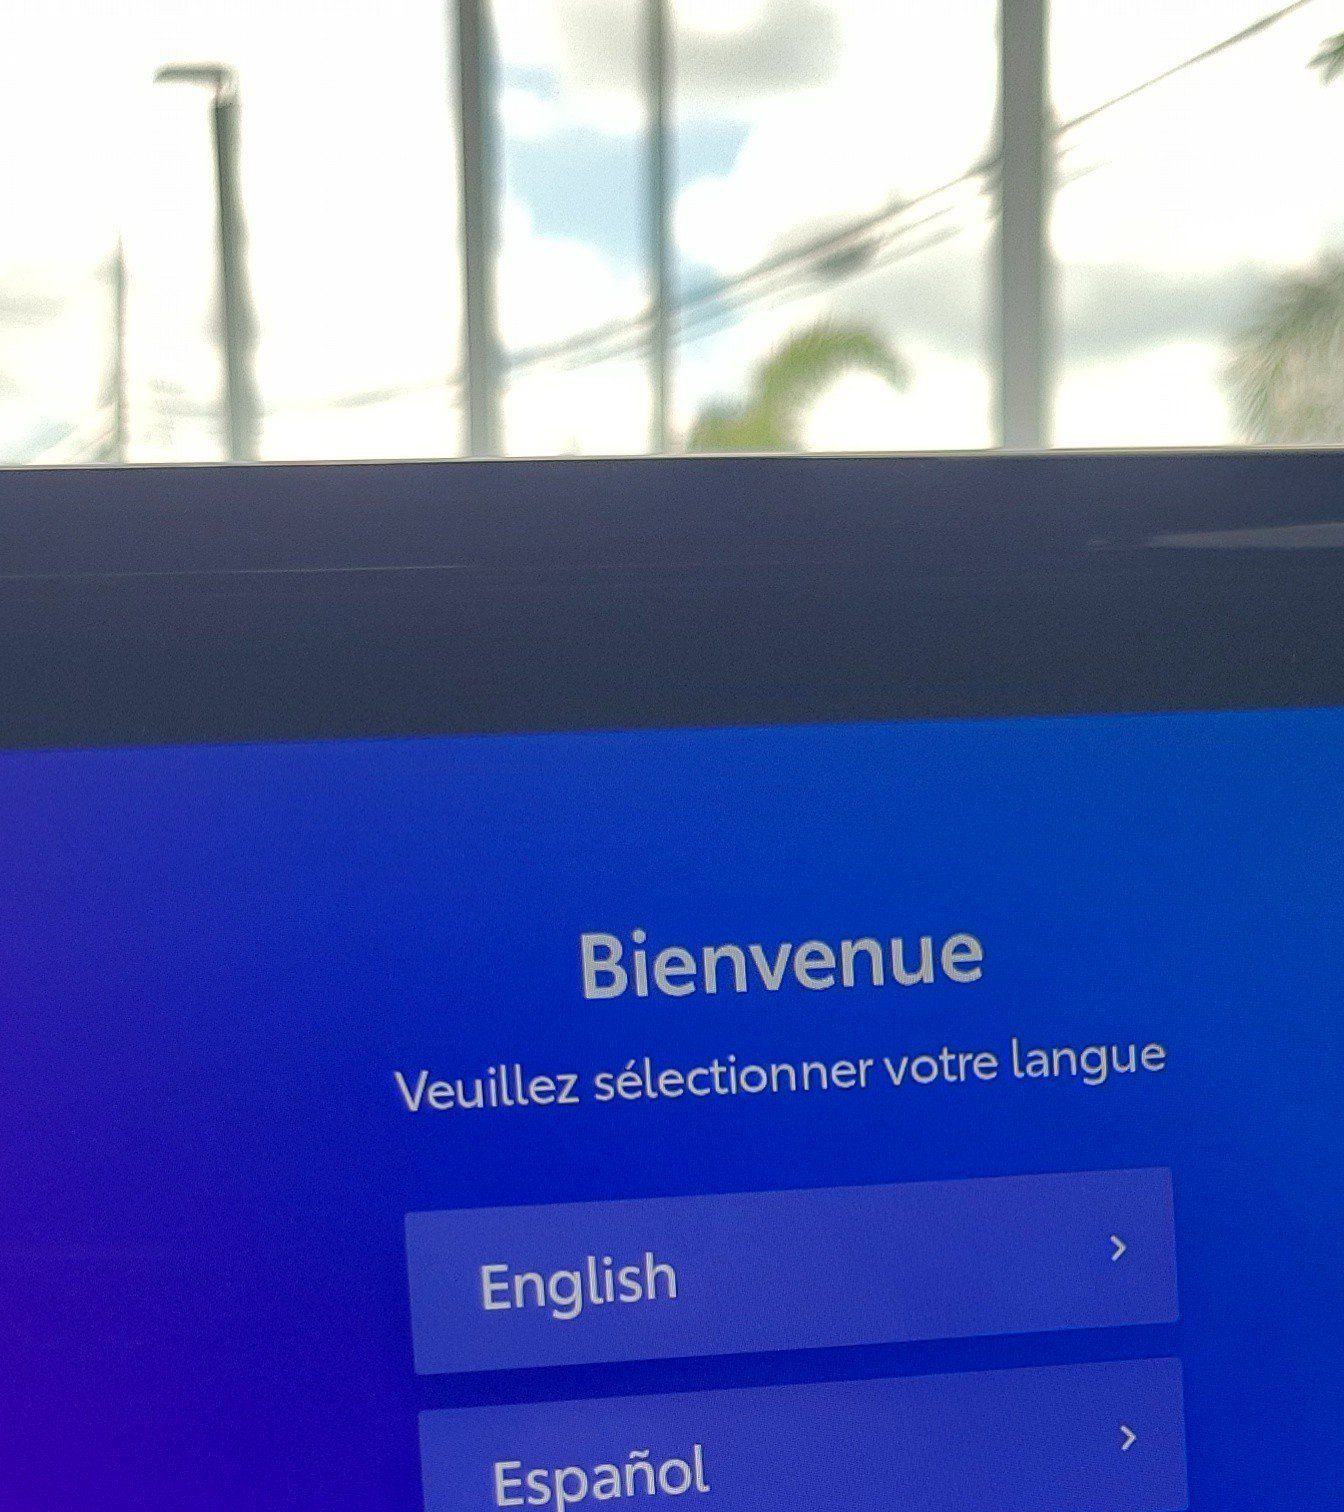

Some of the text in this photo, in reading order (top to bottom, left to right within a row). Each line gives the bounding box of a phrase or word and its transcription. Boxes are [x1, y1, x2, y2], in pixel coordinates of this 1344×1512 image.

[580, 928, 983, 999] Bienvenue
[394, 1037, 1165, 1111] Veuillez sélectionner votre langue
[480, 1251, 677, 1320] English
